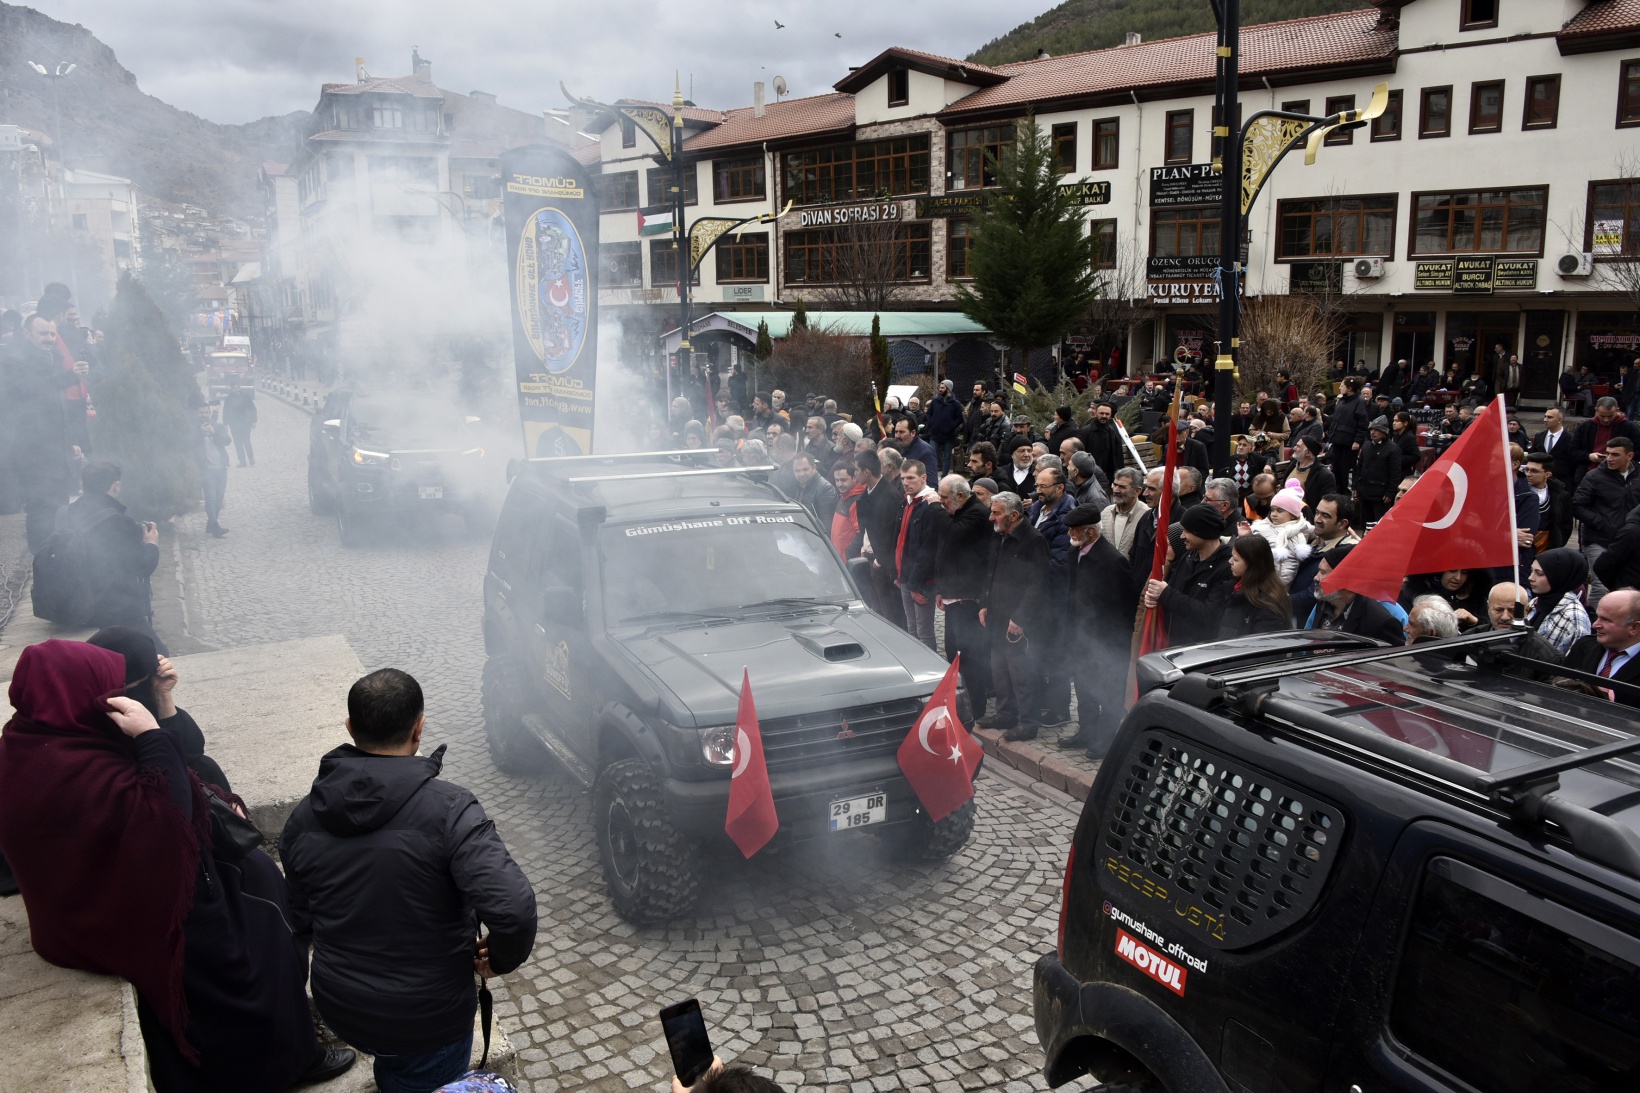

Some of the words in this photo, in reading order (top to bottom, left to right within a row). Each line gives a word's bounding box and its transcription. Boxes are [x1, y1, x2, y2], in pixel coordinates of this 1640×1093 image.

[834, 204, 880, 224] SOFRASI
[882, 204, 897, 220] 29
[1151, 257, 1182, 266] ÖZENÇ
[1458, 260, 1491, 268] AVUKAT
[734, 286, 752, 295] LİDER
[1147, 282, 1244, 299] KURUYEMŞ
[625, 519, 724, 536] Gümüşhane
[727, 517, 751, 525] Off
[755, 515, 794, 523] Road
[833, 802, 850, 816] 29
[867, 796, 883, 809] DR
[846, 812, 870, 826] 185
[1104, 856, 1168, 900] RECEP
[1111, 906, 1208, 973] gumushane_offroad
[1118, 935, 1182, 990] MOTUL
